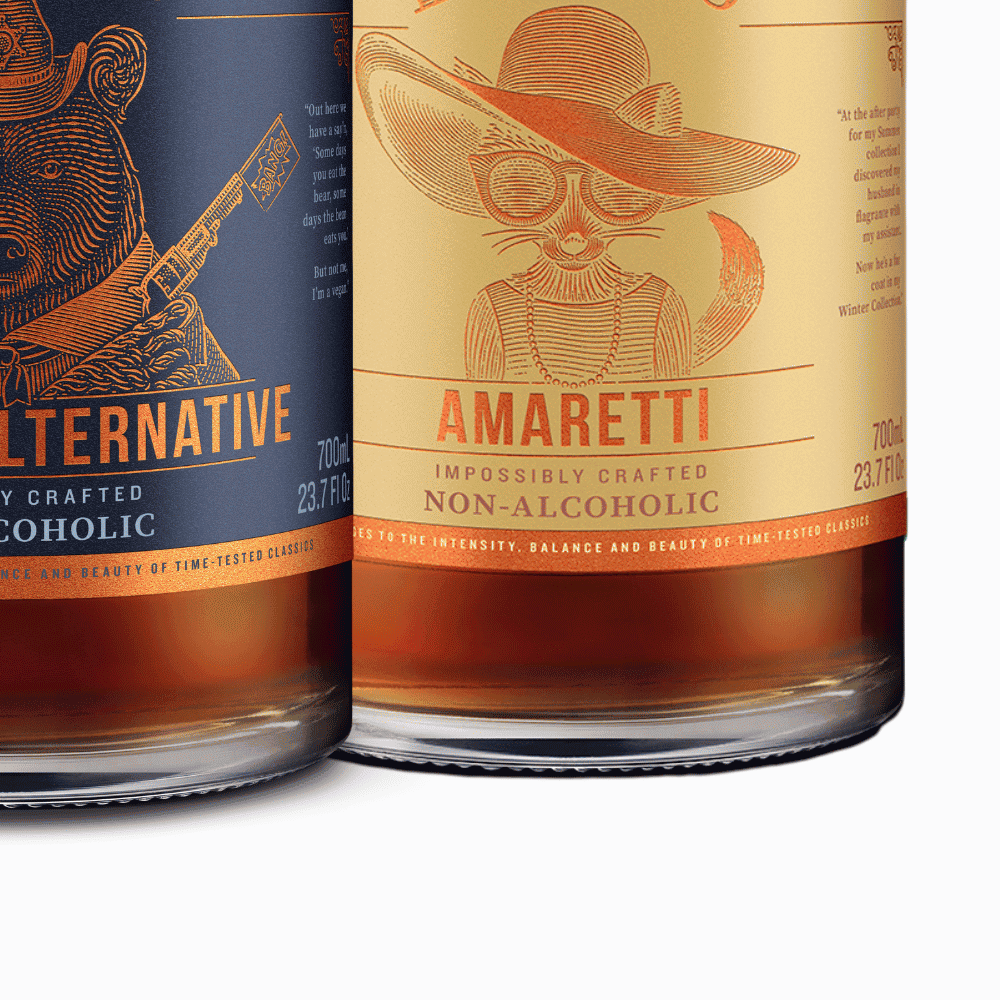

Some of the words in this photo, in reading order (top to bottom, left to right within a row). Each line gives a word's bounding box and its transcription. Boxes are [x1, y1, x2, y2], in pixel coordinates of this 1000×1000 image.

[324, 102, 339, 115] here
[853, 106, 867, 121] the
[308, 124, 327, 138] have
[328, 126, 333, 137] a
[848, 127, 862, 141] for
[864, 129, 876, 143] my
[259, 130, 289, 196] BANG!
[312, 170, 327, 185] you
[328, 166, 338, 179] eat
[313, 189, 332, 203] bear,
[302, 213, 322, 229] days
[323, 209, 335, 223] the
[323, 231, 337, 245] eats
[863, 232, 874, 245] my
[313, 265, 327, 279] But
[328, 262, 339, 276] not
[855, 260, 874, 275] Now
[312, 286, 325, 301] I'm
[326, 287, 331, 298] a
[838, 303, 870, 318] Winter
[436, 388, 709, 447] AMARETTI
[317, 433, 351, 471] 700mL
[435, 463, 584, 484] IMPOSSIBLY
[599, 464, 708, 484] CRAFTED
[854, 458, 883, 492] 23.7
[28, 485, 143, 505] CRAFTED
[297, 478, 328, 515] 23.7
[424, 489, 719, 519] NON-ALCOHOLIC
[378, 530, 395, 542] TO
[401, 533, 426, 546] THE
[530, 541, 603, 553] BALANCE
[611, 541, 640, 553] AND
[649, 538, 708, 552] BEAUTY
[715, 536, 731, 548] OF
[738, 525, 821, 547] TIME-TESTED
[826, 514, 870, 535] CLASSICS
[40, 567, 72, 580] AND
[81, 563, 143, 579] BEAUTY
[150, 562, 167, 575] OF
[175, 550, 264, 572] TIME-TESTED
[268, 538, 315, 560] CLASSICS
